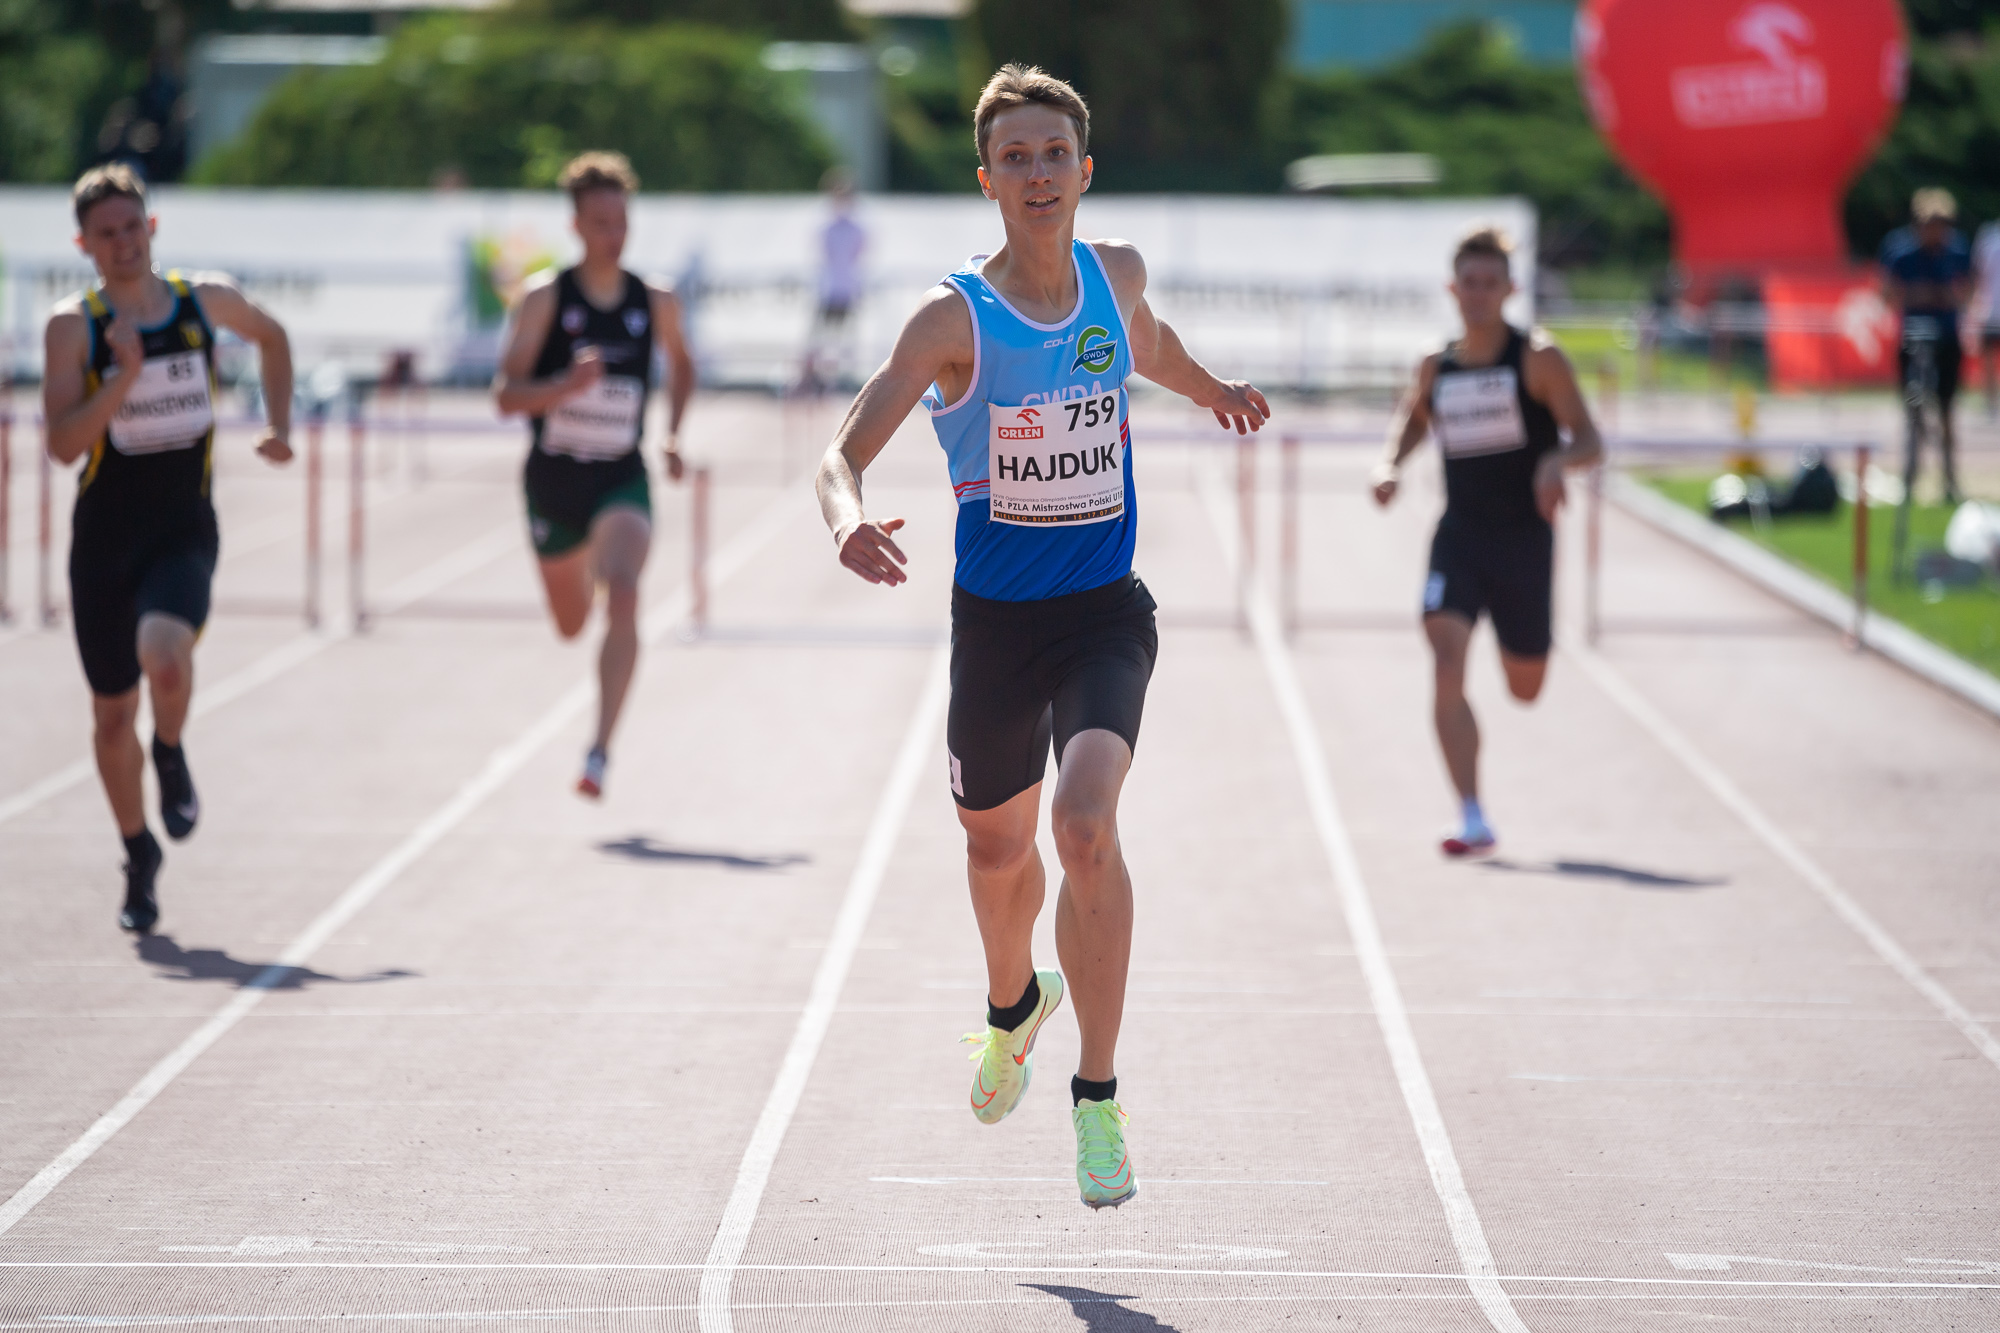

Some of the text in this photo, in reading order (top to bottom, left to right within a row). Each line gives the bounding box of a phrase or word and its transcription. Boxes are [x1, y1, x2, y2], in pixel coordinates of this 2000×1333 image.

[1083, 349, 1107, 361] GWDA
[1064, 395, 1115, 432] 759
[1000, 427, 1041, 438] ORLEN
[997, 442, 1118, 482] HAJDUK
[993, 499, 1005, 509] 54.
[1007, 501, 1029, 512] PZLA
[1031, 501, 1087, 512] Mistrzostwa
[1089, 494, 1111, 507] Polski
